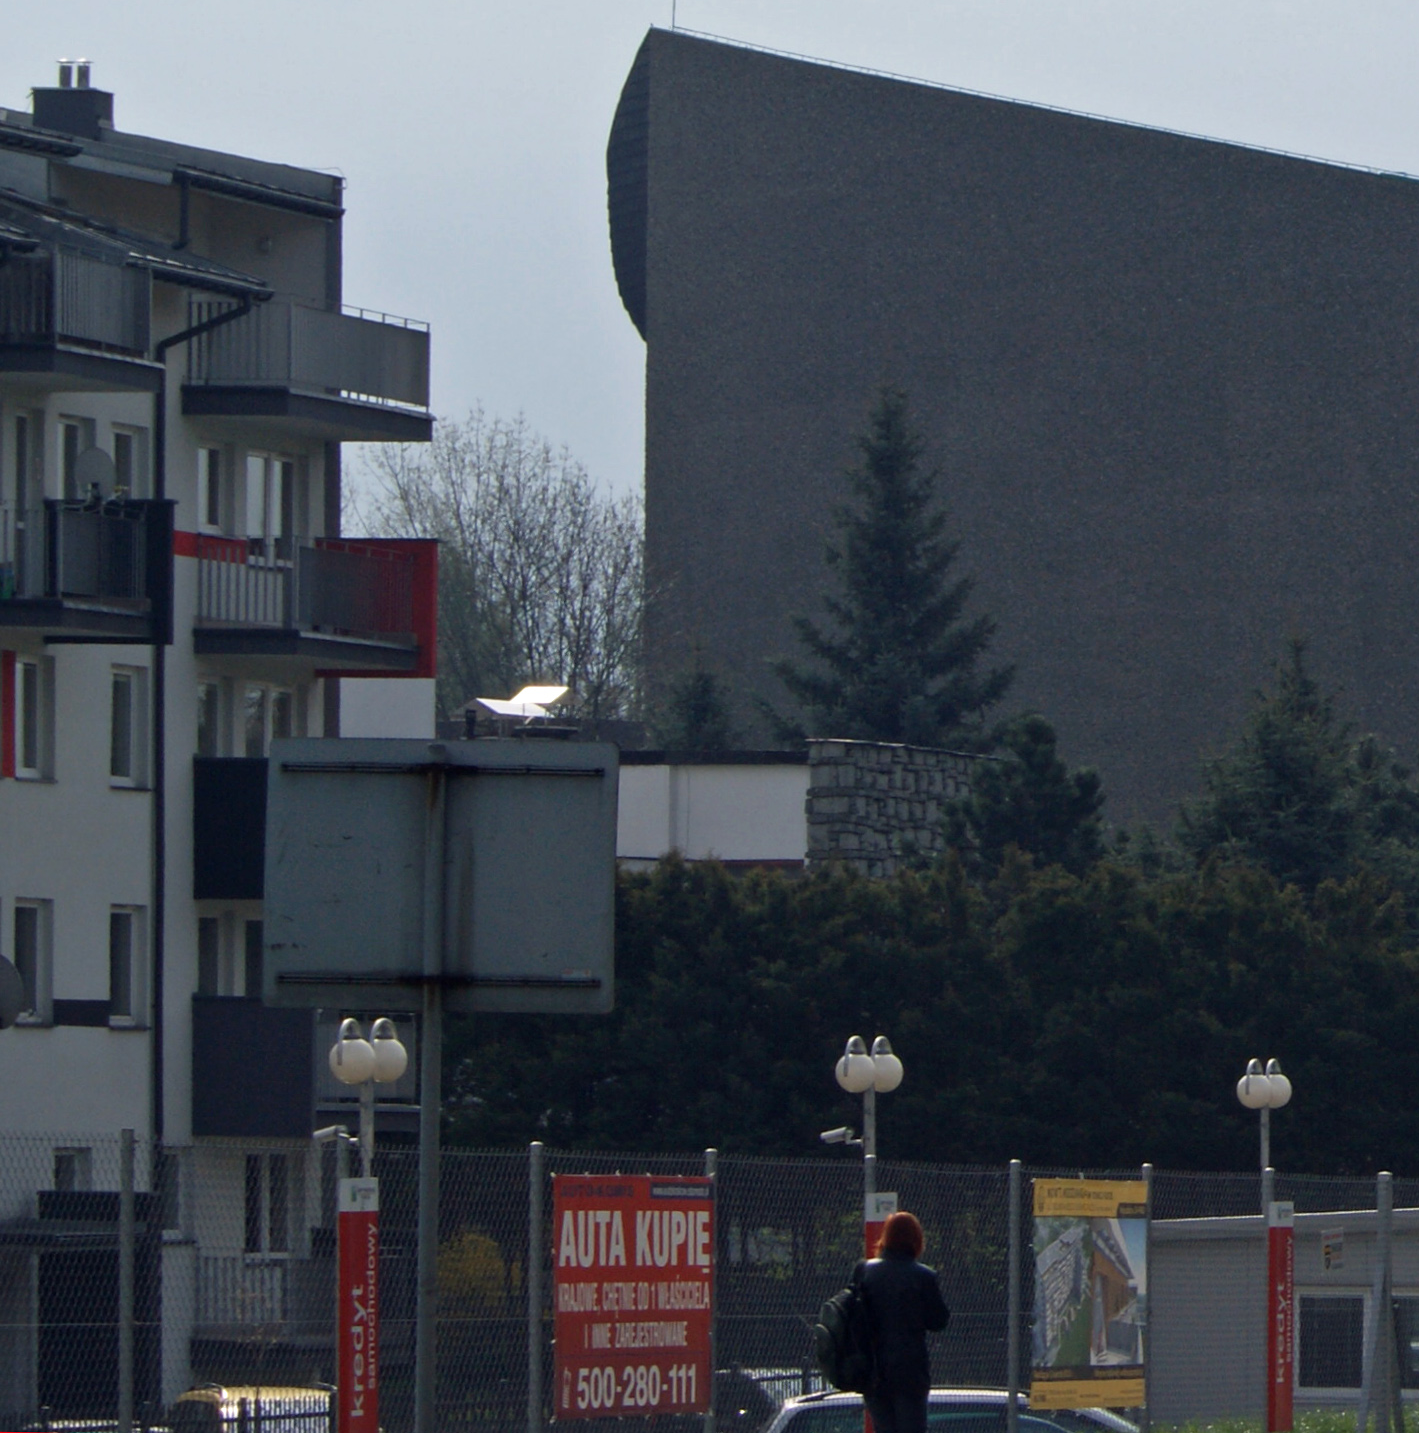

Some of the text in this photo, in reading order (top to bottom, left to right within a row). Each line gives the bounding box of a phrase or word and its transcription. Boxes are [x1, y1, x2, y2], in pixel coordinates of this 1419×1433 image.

[558, 1210, 710, 1274] AUTA KUPIĘ
[366, 1222, 378, 1390] samochodowy
[637, 1281, 649, 1311] OD
[650, 1282, 656, 1310] 1
[1276, 1282, 1287, 1384] kredyt
[350, 1284, 367, 1417] kredyt
[577, 1363, 697, 1410] 500-280-111
